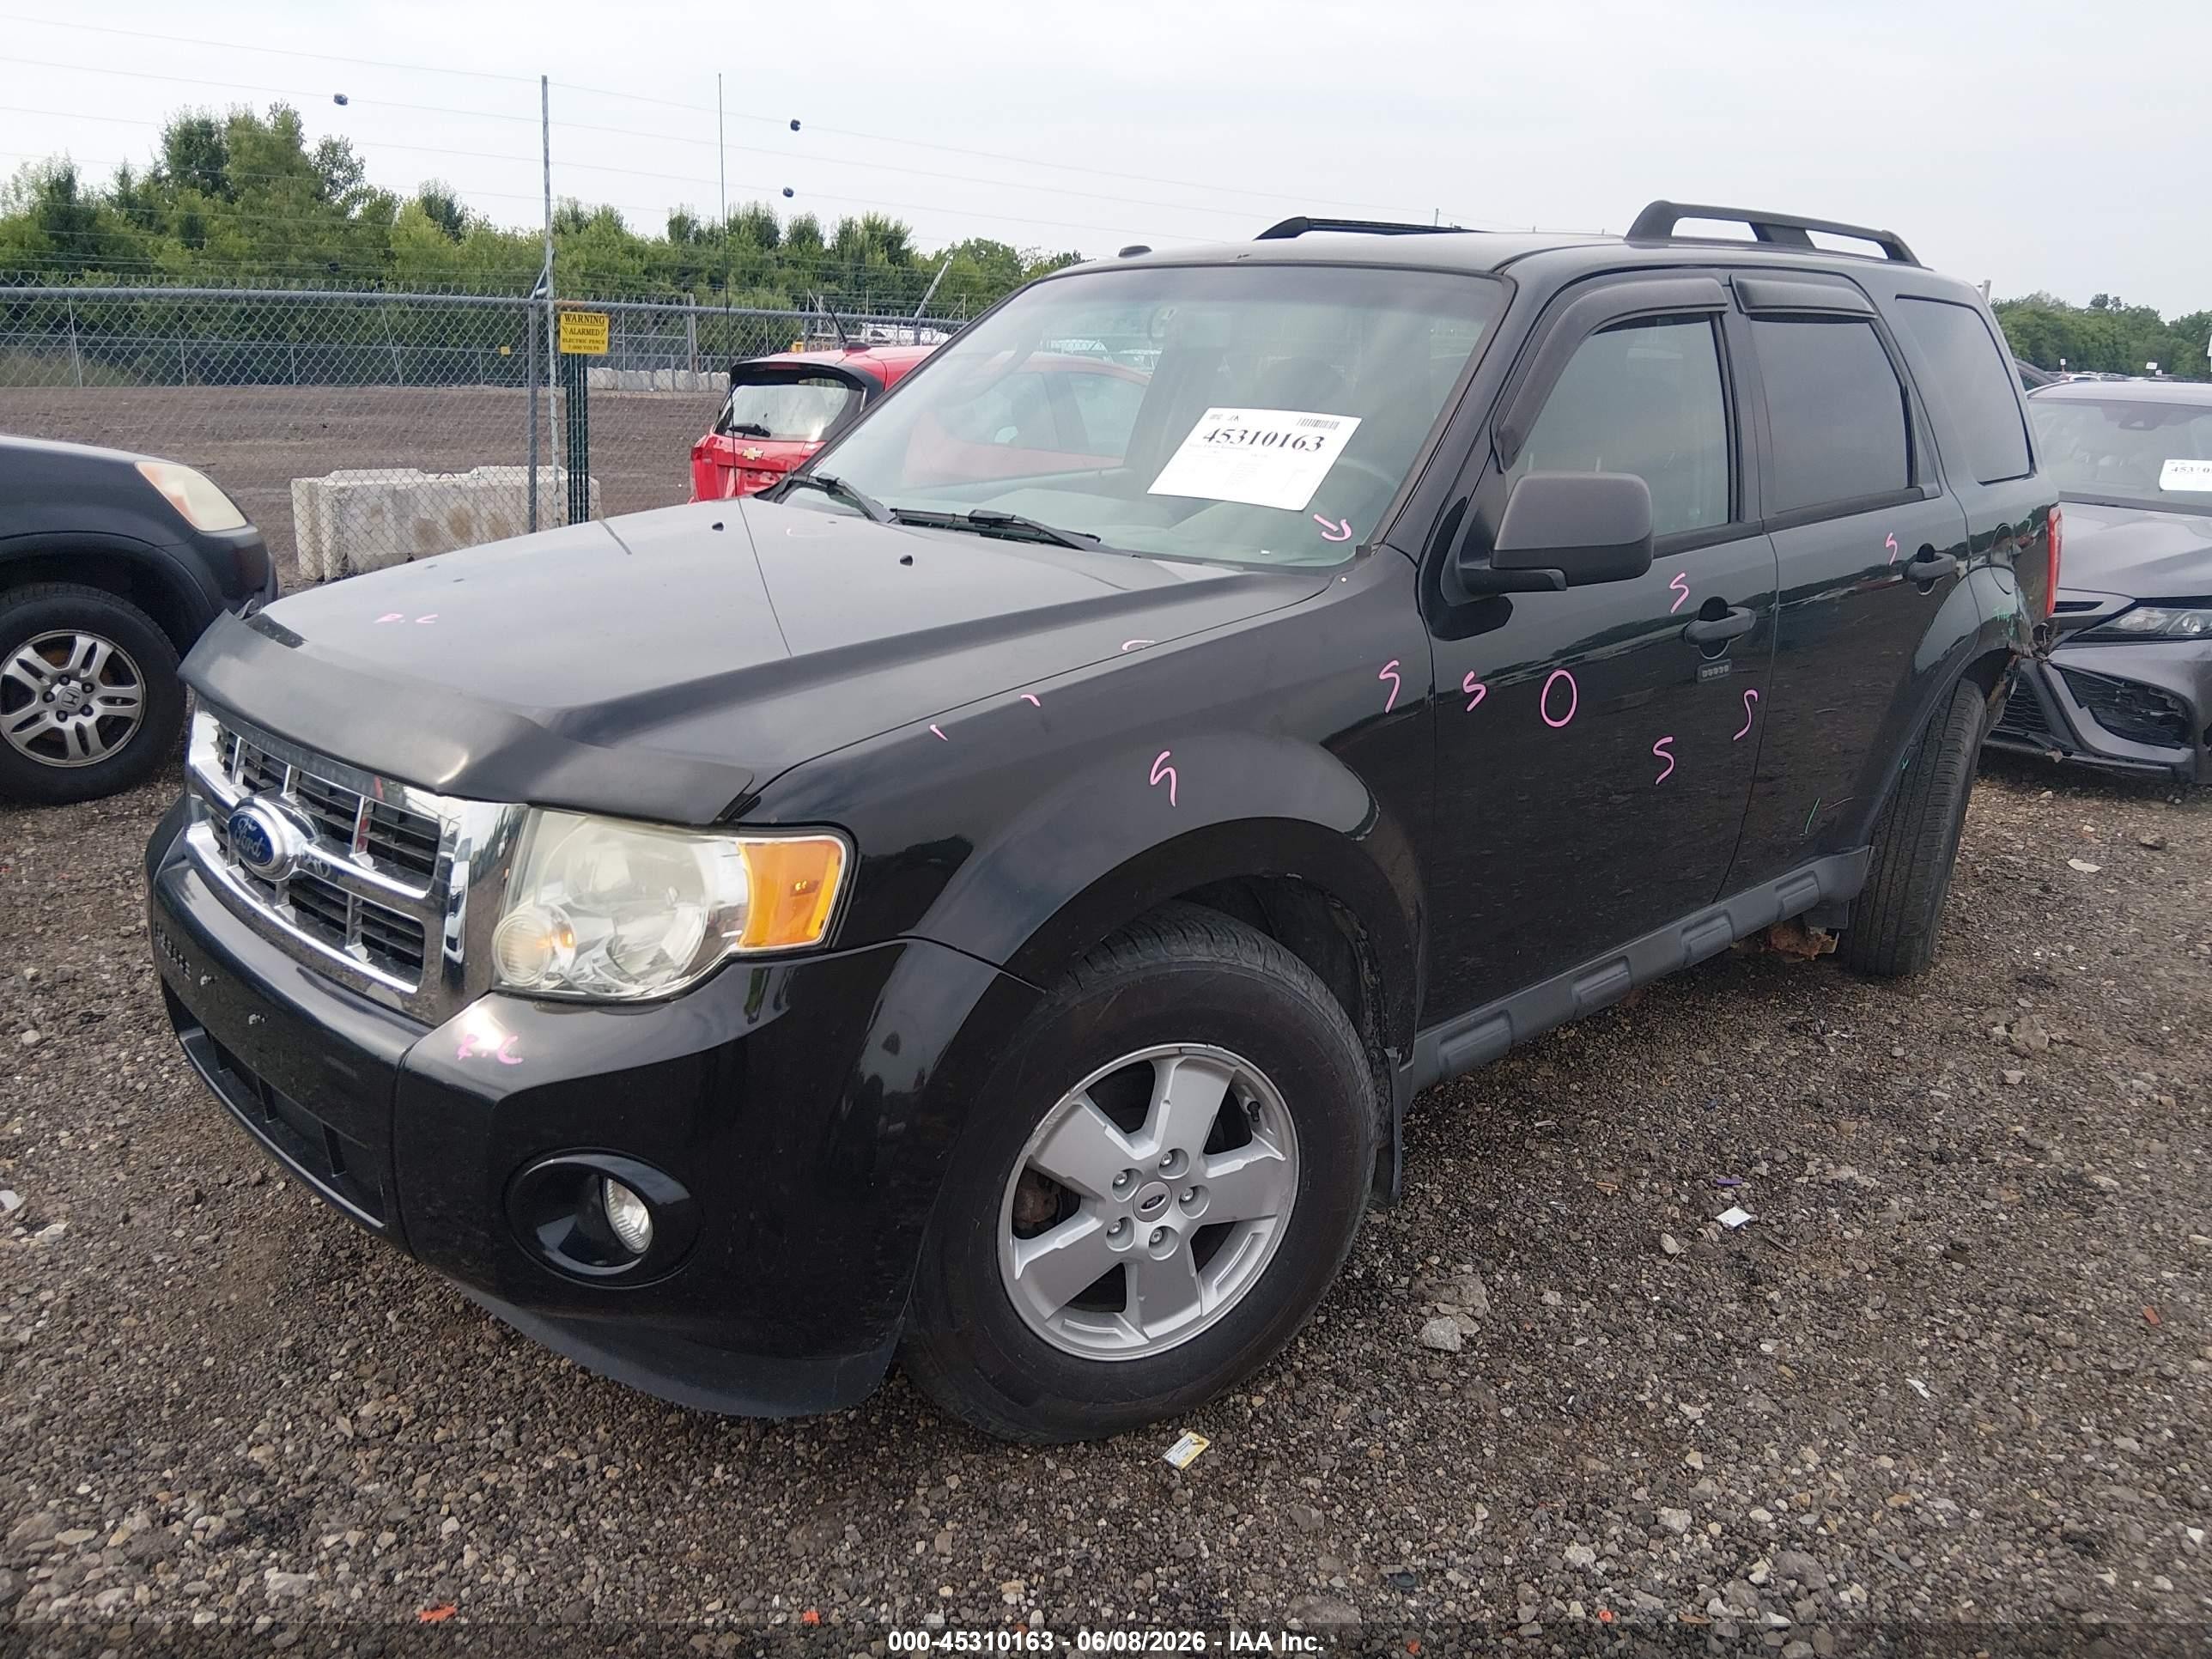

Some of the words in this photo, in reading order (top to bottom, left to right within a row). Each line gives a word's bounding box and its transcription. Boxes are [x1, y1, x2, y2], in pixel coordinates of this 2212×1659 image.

[564, 313, 605, 325] WARNING
[568, 327, 600, 336] ALARMED
[1203, 428, 1325, 453] 45310163
[234, 817, 264, 857] Ford
